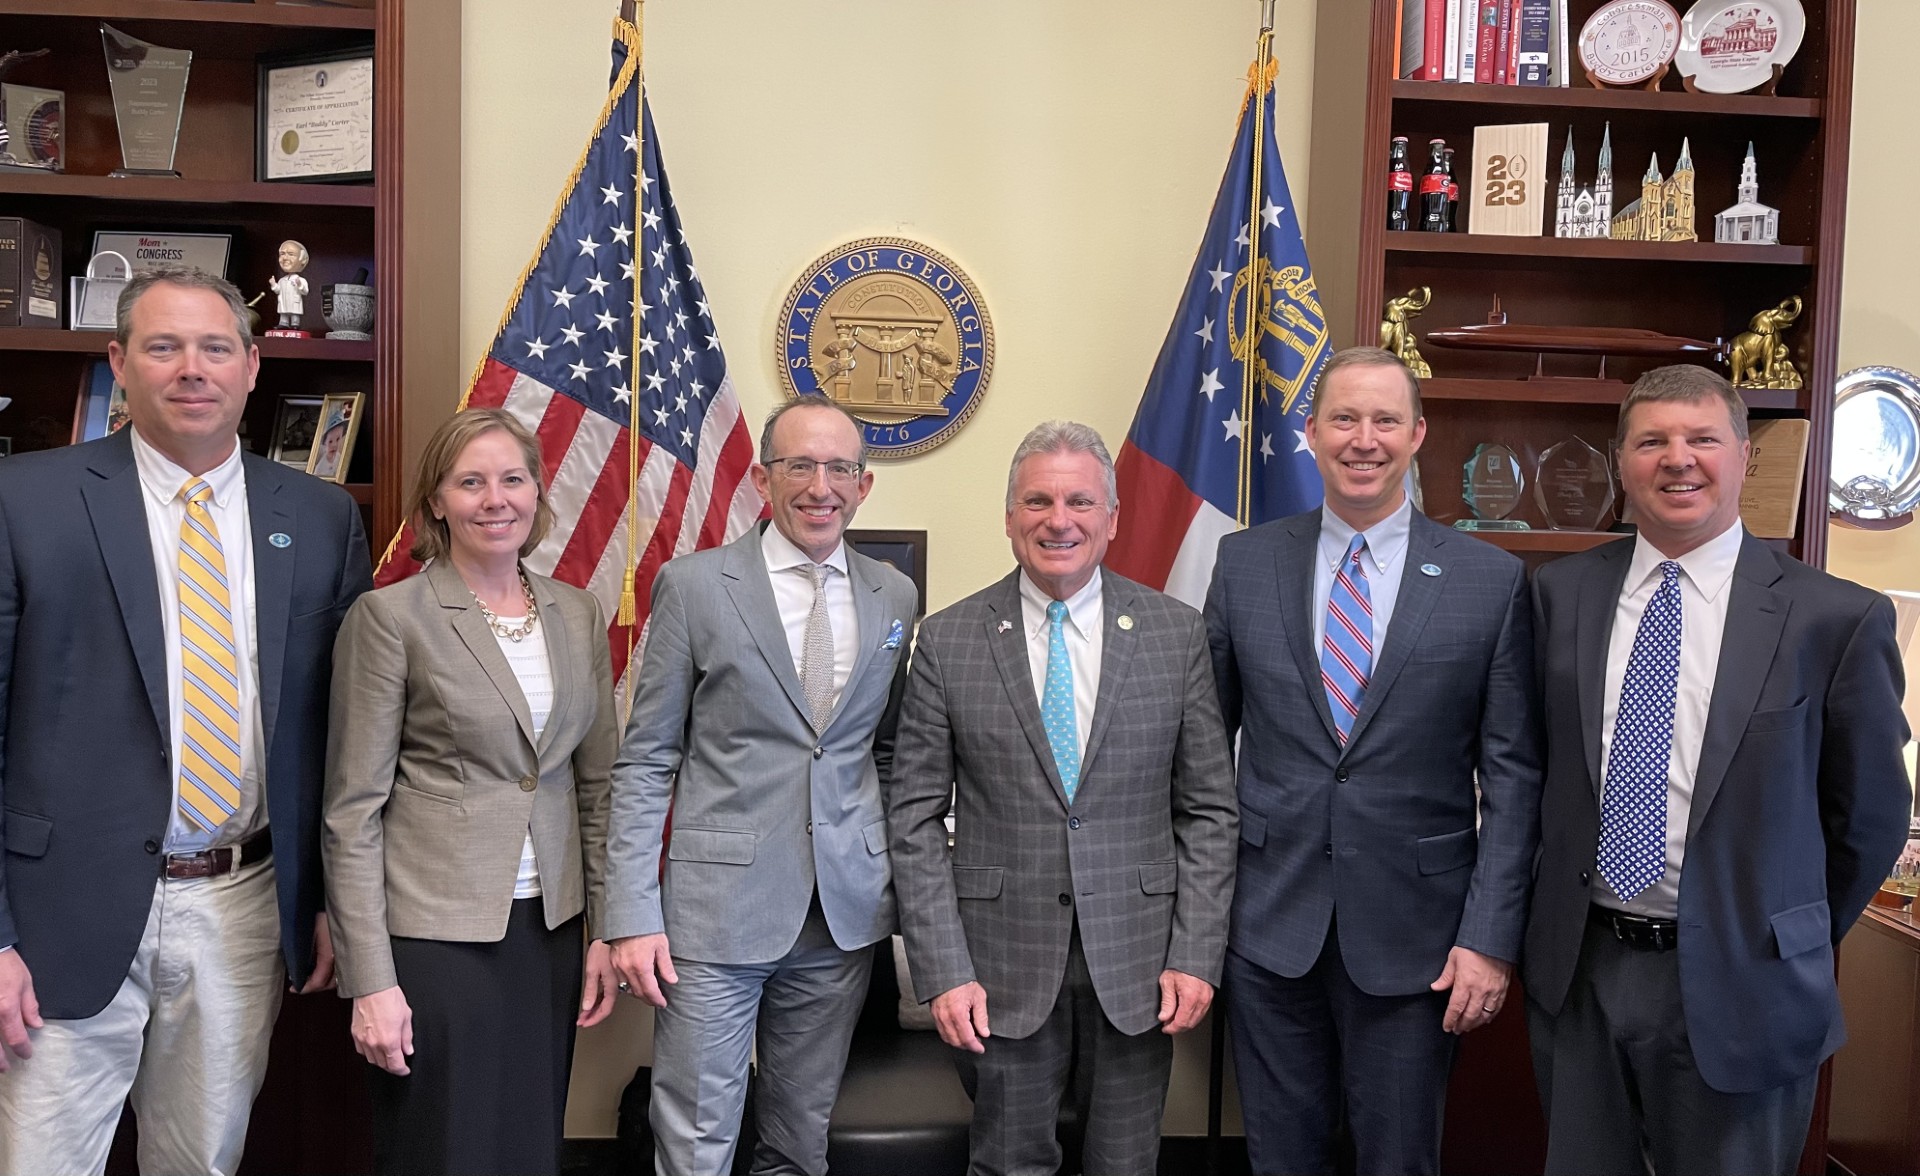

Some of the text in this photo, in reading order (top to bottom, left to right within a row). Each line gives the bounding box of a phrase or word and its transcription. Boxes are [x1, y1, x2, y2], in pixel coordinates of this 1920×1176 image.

[1501, 8, 1509, 29] STATE
[1596, 4, 1666, 26] Congressman
[1586, 52, 1615, 76] Buddy
[1619, 62, 1655, 79] Carter
[1611, 48, 1649, 66] 2015
[285, 105, 316, 113] CERTIFICATE
[324, 101, 359, 110] APPRECIATION
[138, 238, 161, 247] Mom
[136, 248, 183, 260] CONGRESS
[1275, 268, 1300, 288] MODER
[848, 282, 930, 314] CONSTITUTION
[1294, 281, 1314, 298] ATION
[789, 250, 982, 373] STATE OF GEORGIA
[1295, 400, 1310, 416] IN
[1305, 373, 1321, 401] GOD
[1750, 447, 1761, 458] IP
